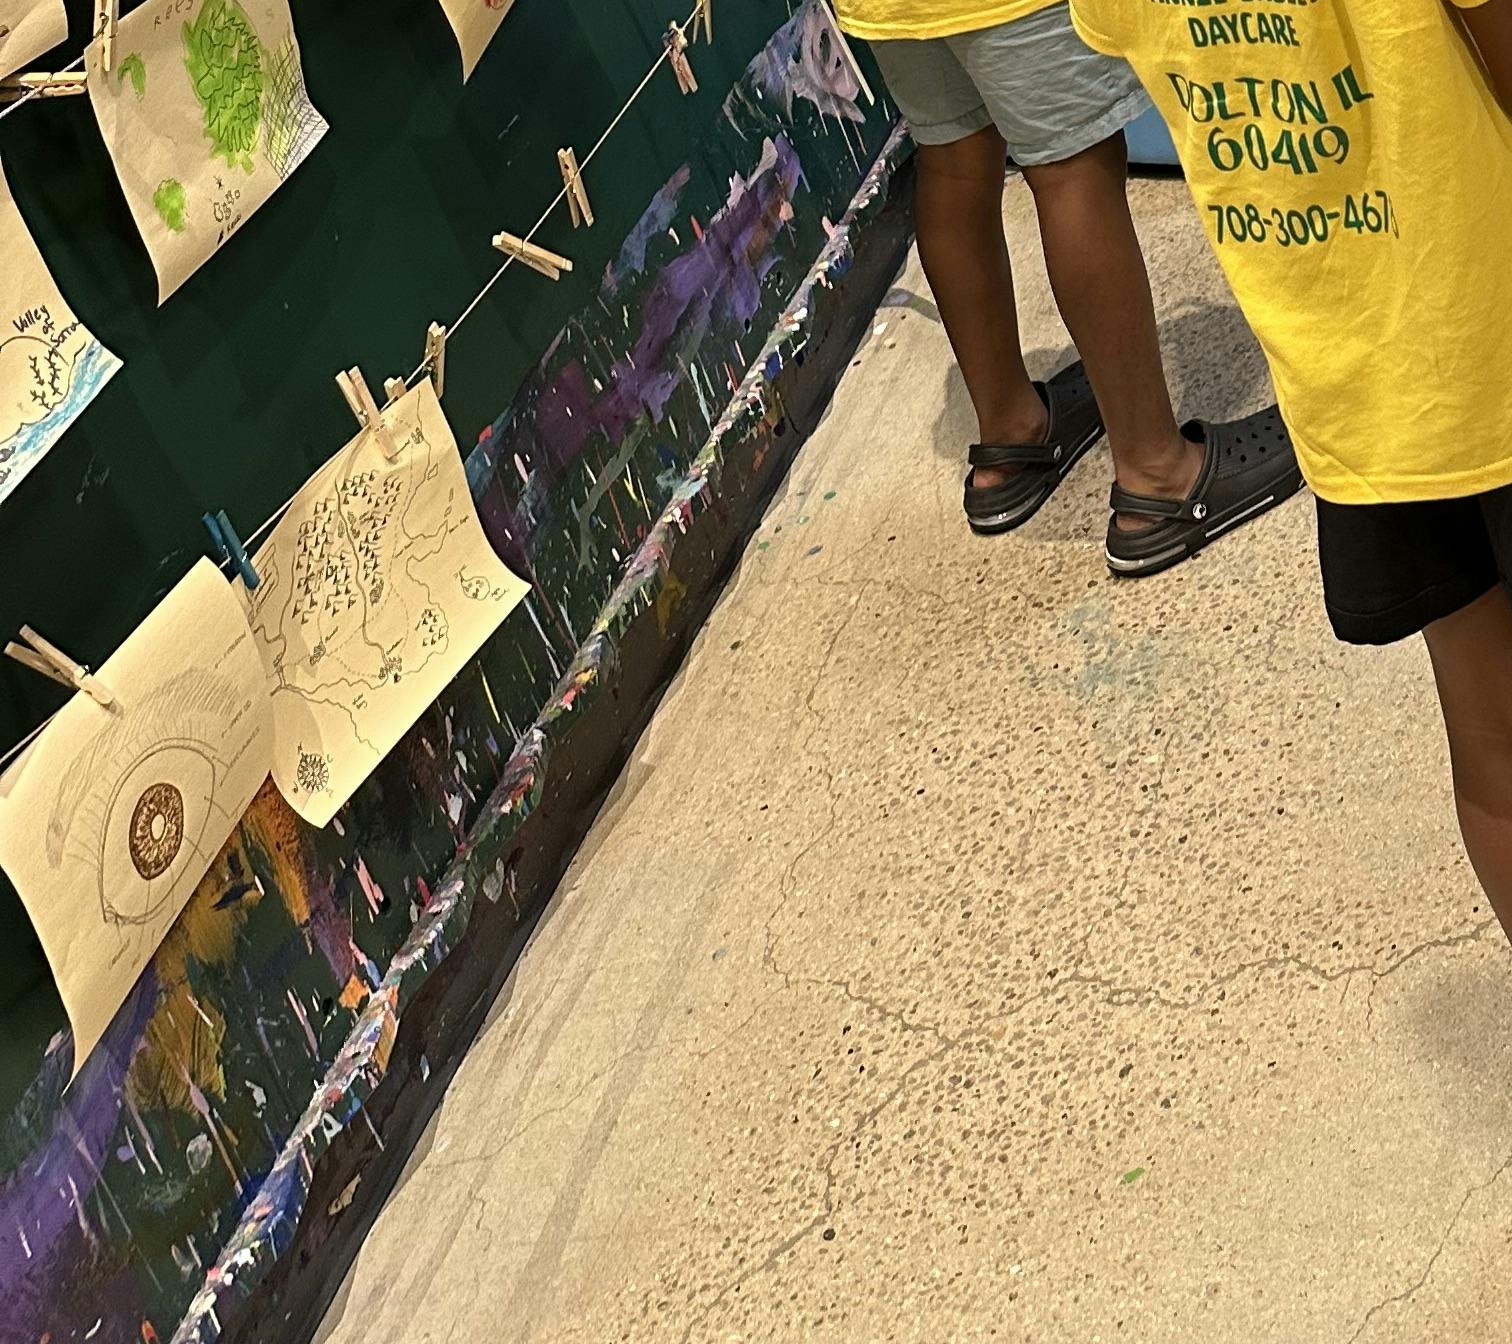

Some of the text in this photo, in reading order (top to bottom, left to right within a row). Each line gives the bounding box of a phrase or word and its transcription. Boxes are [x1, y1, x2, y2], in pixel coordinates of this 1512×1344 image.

[1188, 12, 1300, 48] DAYCARE
[1165, 64, 1374, 125] DOLTON IL
[1207, 124, 1350, 175] 60419
